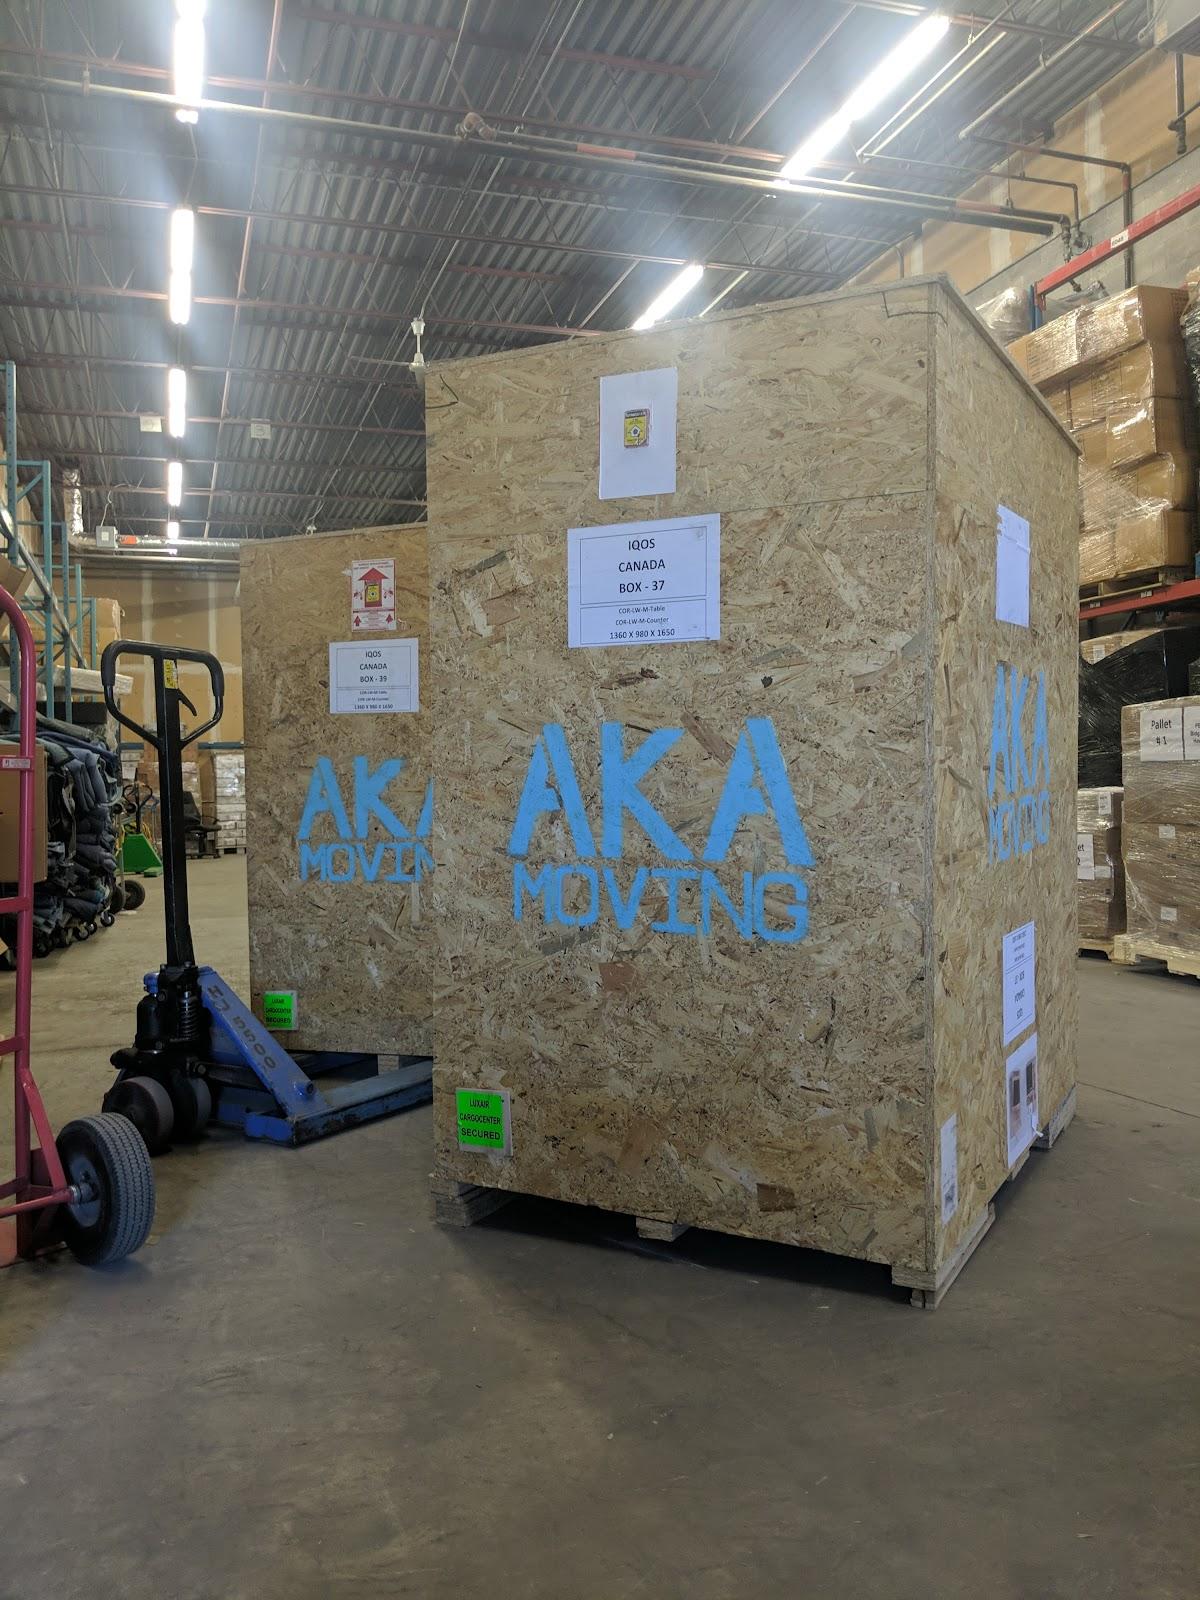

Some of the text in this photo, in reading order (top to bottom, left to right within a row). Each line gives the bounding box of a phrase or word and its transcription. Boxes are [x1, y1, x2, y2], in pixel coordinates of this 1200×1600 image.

[628, 538, 656, 552] IQOS
[618, 559, 666, 573] CANADA
[619, 581, 642, 594] BOX
[651, 579, 665, 591] 37
[609, 631, 627, 640] 1360
[635, 630, 649, 638] 980
[657, 628, 675, 637] 1650
[365, 650, 382, 658] IQOS
[359, 662, 388, 671] CANADA
[360, 675, 374, 683] BOX
[988, 664, 1050, 796] AKA
[1151, 718, 1172, 730] Pallet
[507, 716, 816, 867] AKA
[513, 862, 808, 944] MOVING
[469, 1098, 490, 1109] LUXAIR
[459, 1112, 501, 1125] CARGOCENTER
[461, 1127, 501, 1140] SECURED
